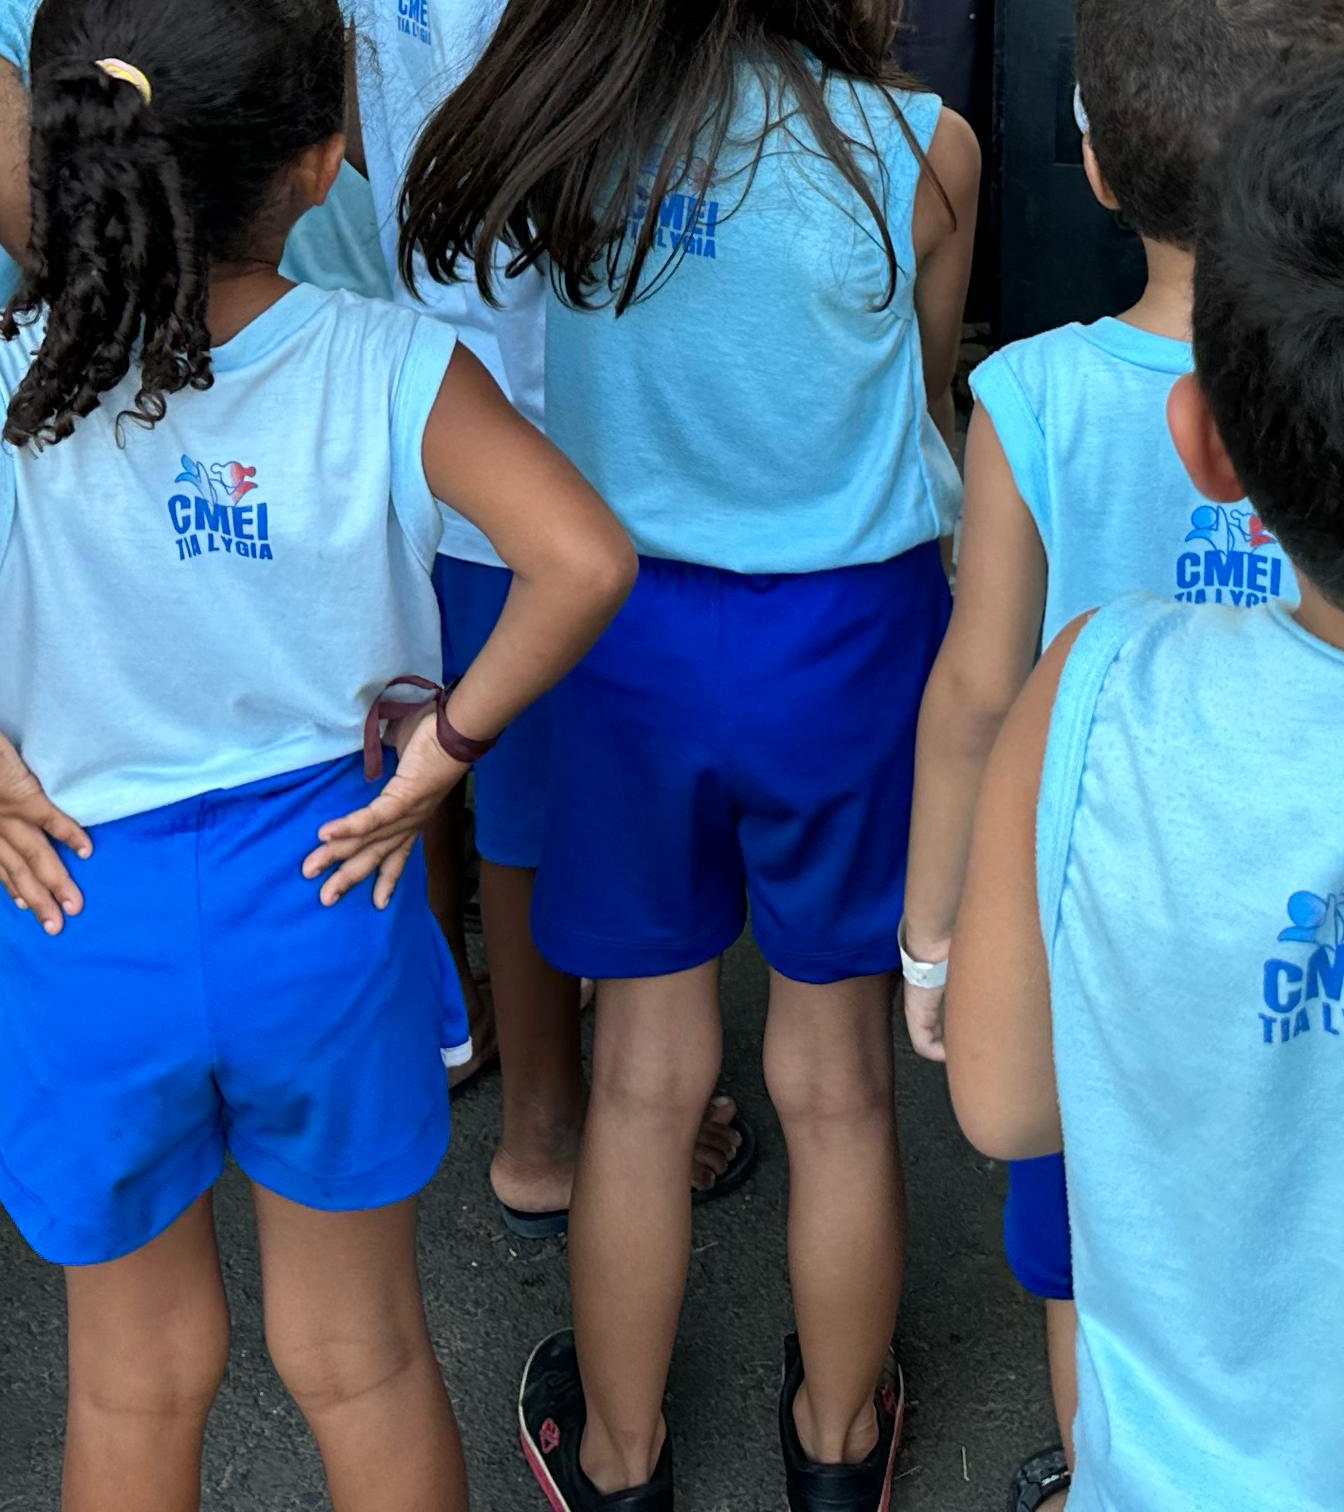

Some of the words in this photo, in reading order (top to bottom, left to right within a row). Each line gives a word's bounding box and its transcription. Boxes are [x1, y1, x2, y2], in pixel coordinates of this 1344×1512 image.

[168, 494, 269, 541] CMEI
[176, 534, 202, 561] TIA
[208, 533, 273, 560] LYGIA
[1176, 550, 1281, 597] CMEI
[1258, 1007, 1311, 1044] TIA
